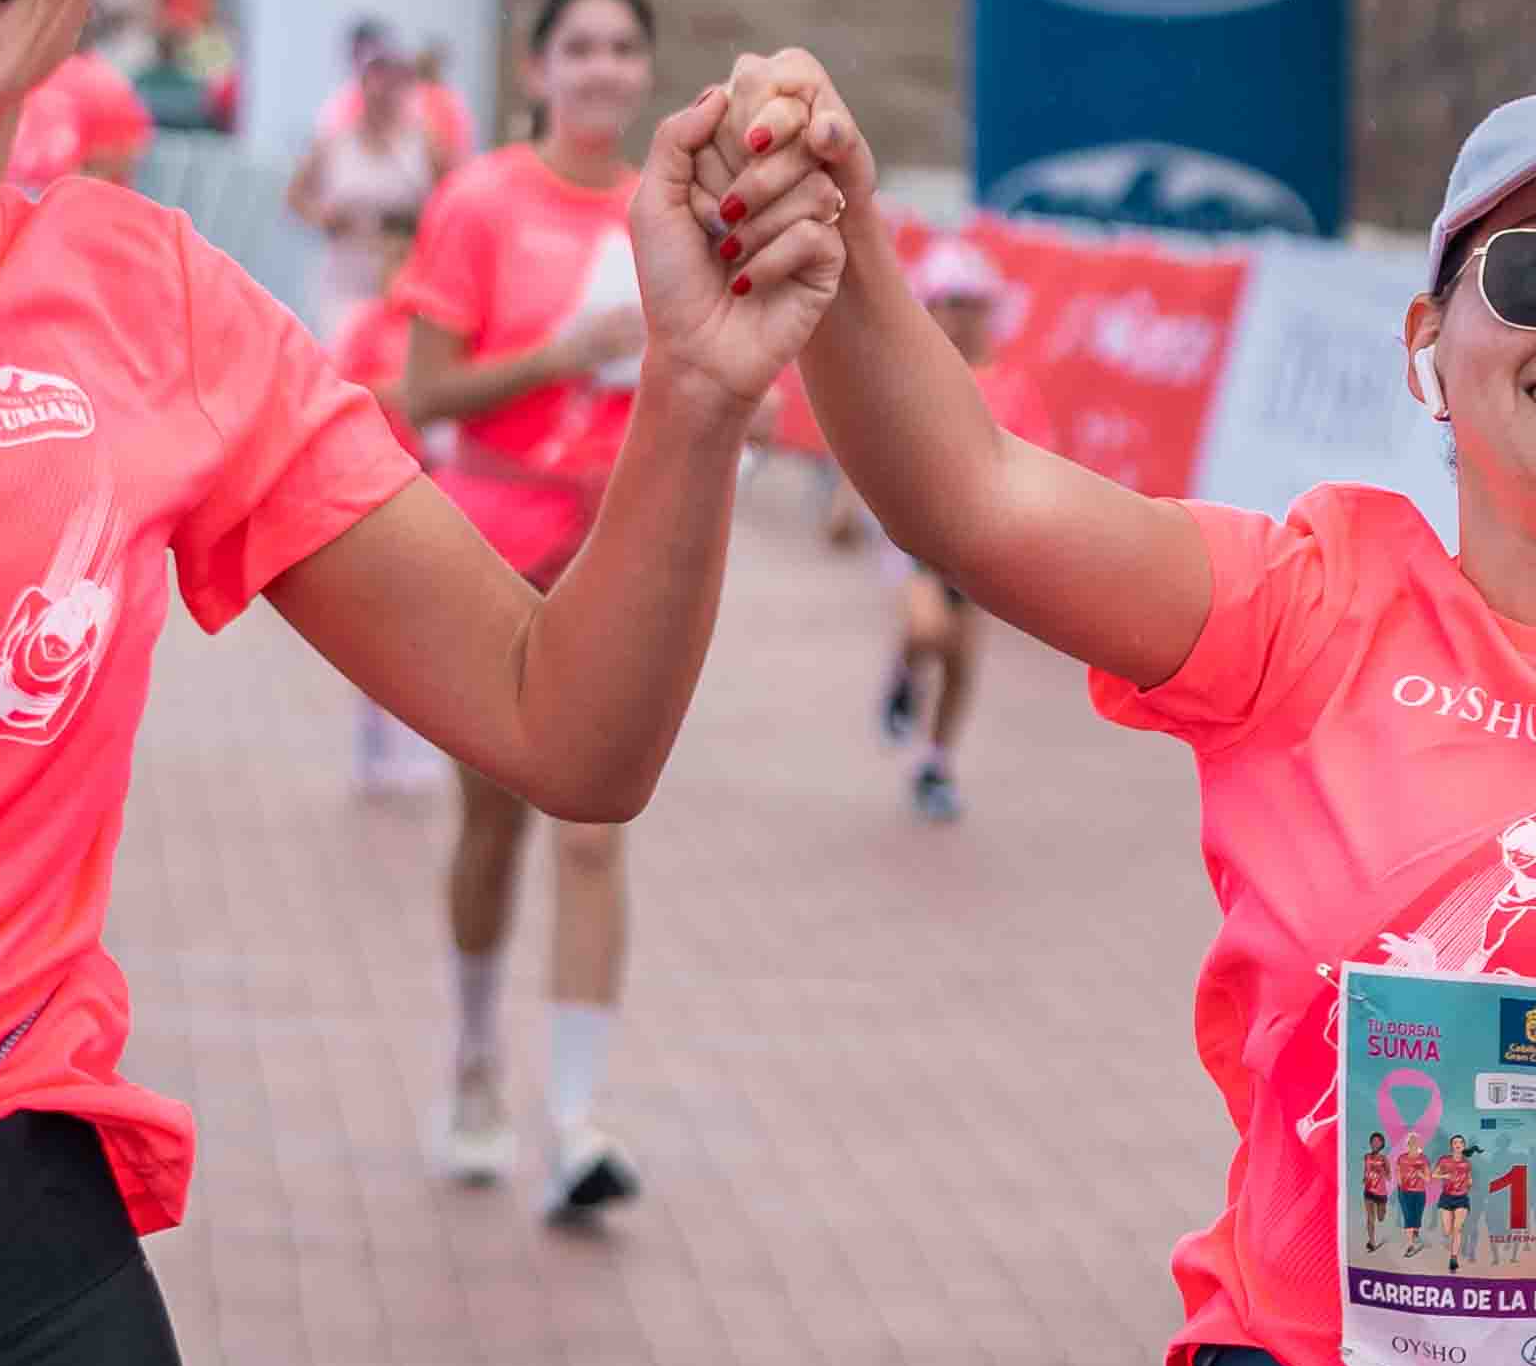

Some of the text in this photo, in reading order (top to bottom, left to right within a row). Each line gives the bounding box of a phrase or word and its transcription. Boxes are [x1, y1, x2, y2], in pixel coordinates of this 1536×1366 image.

[1386, 1021, 1443, 1039] DORSAL
[1366, 1036, 1441, 1062] SUMA
[1358, 1278, 1456, 1309] CARRERA
[1463, 1287, 1492, 1311] DE
[1498, 1288, 1527, 1312] LA
[1391, 1335, 1467, 1364] OYSHO
